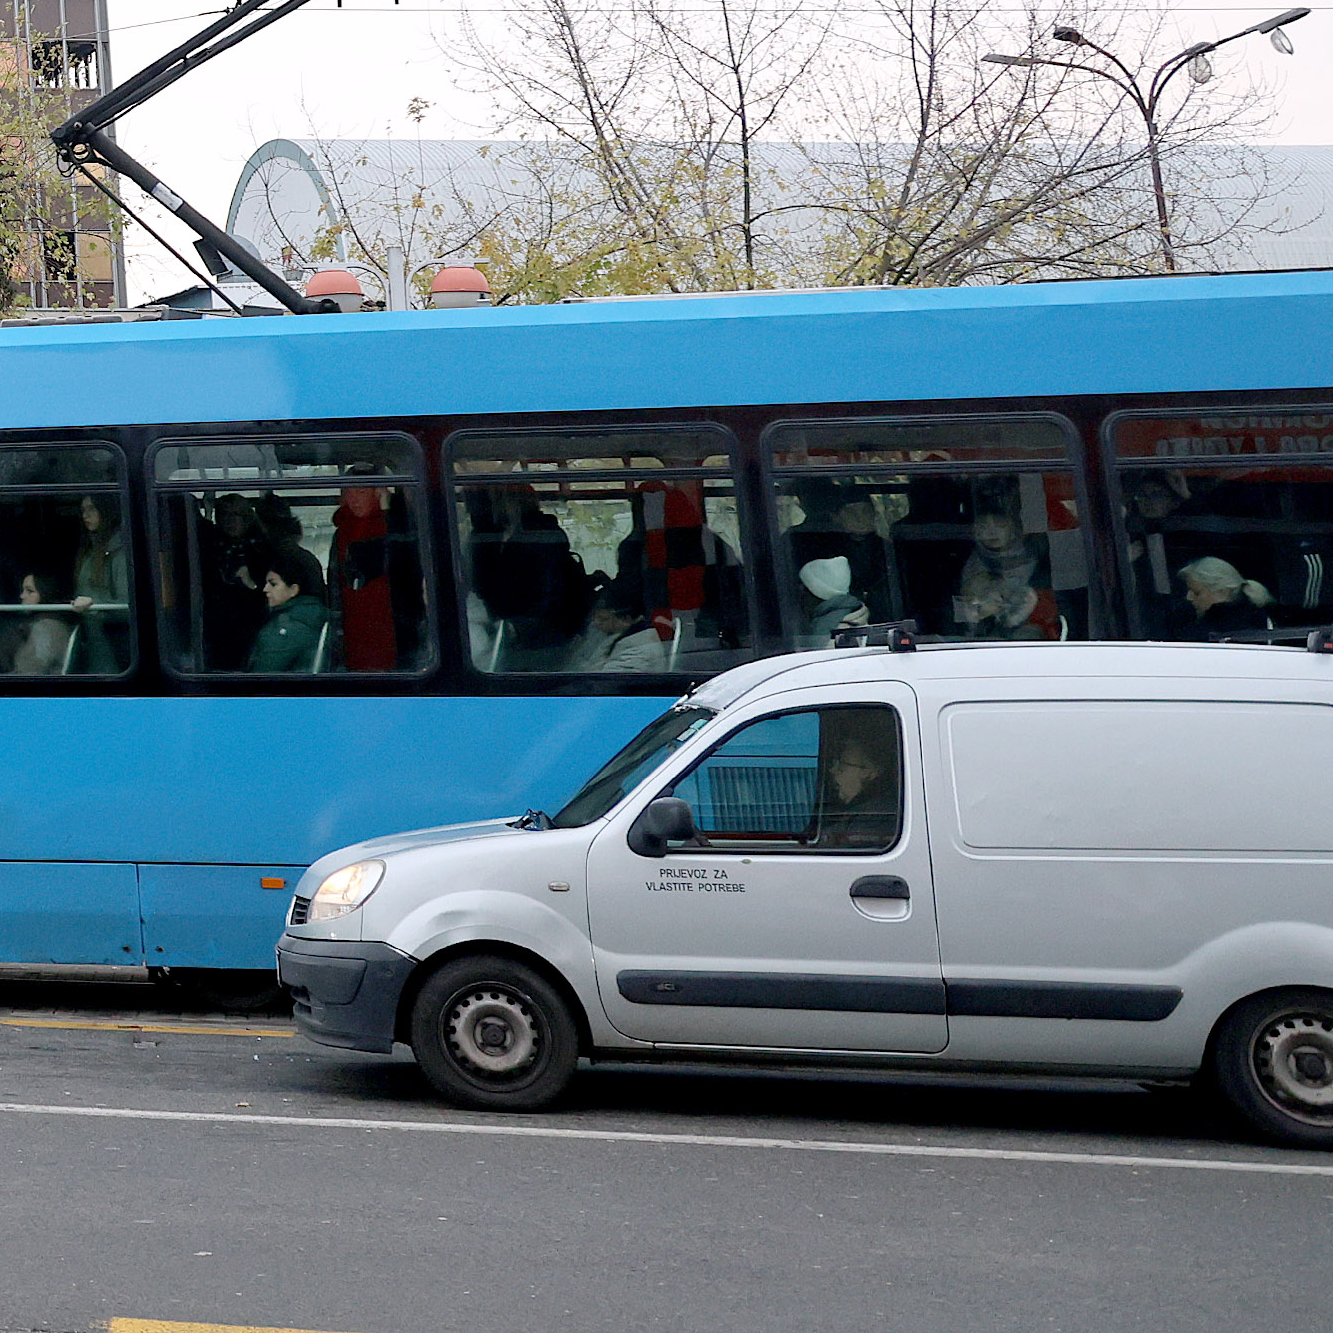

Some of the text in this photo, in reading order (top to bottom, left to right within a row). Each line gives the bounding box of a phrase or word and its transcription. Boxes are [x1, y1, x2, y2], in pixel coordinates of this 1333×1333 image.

[659, 868, 729, 880] PRIJEVOZ ZA
[645, 882, 746, 893] VLASTITE POTREBE
